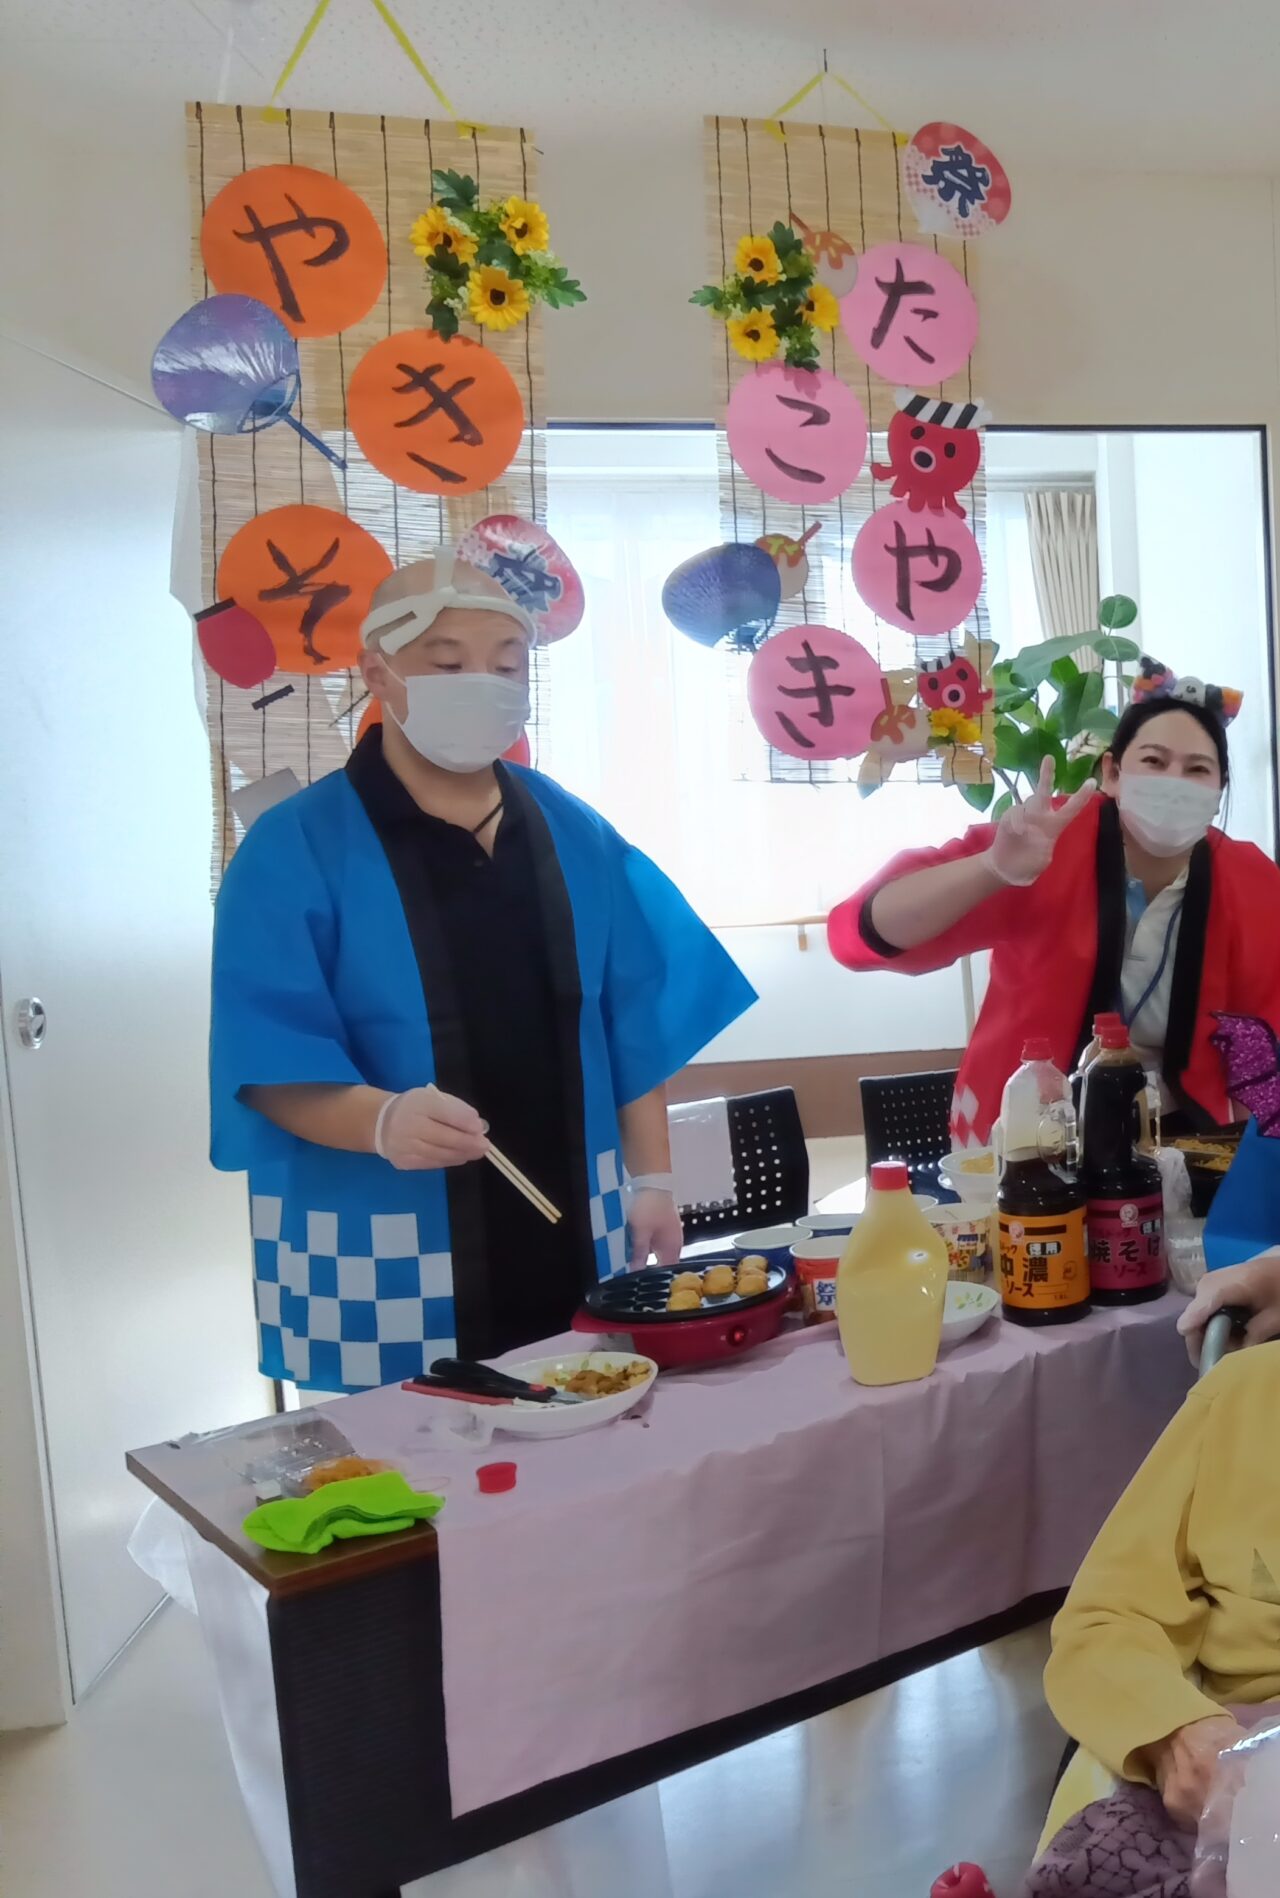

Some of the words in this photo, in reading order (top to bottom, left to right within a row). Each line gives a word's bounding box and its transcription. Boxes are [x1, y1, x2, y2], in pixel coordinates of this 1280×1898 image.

[921, 144, 989, 218] 祭
[1006, 1281, 1034, 1298] ソース
